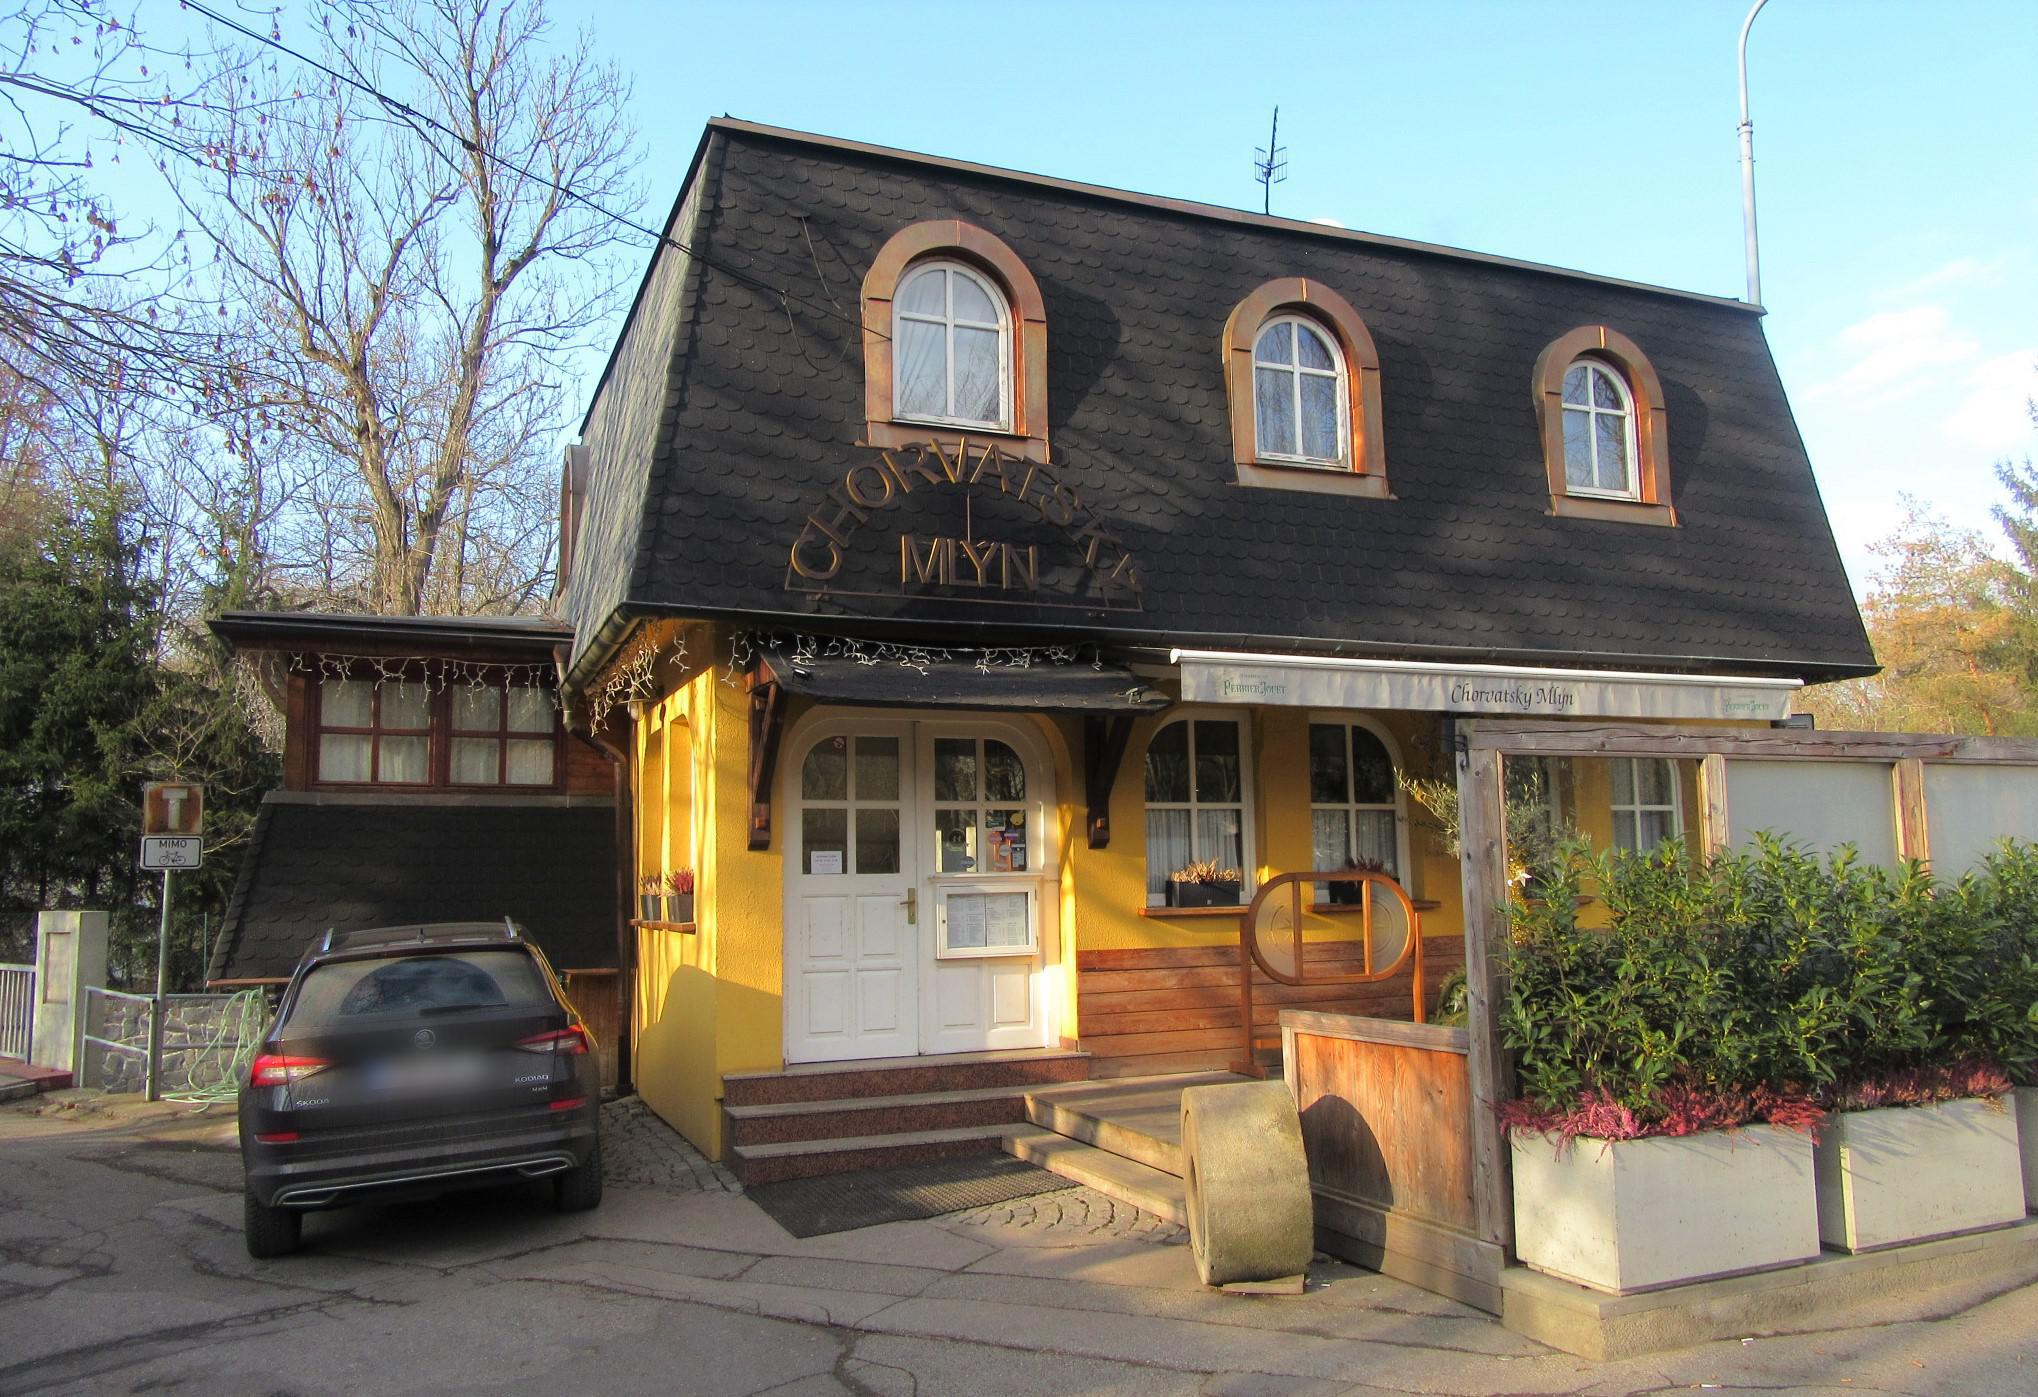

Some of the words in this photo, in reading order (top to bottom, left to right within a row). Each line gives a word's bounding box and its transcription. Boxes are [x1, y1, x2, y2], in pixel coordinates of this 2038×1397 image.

[1451, 682, 1532, 710] Chorvatský
[1536, 686, 1574, 711] Mlýn
[159, 840, 187, 849] MIMO
